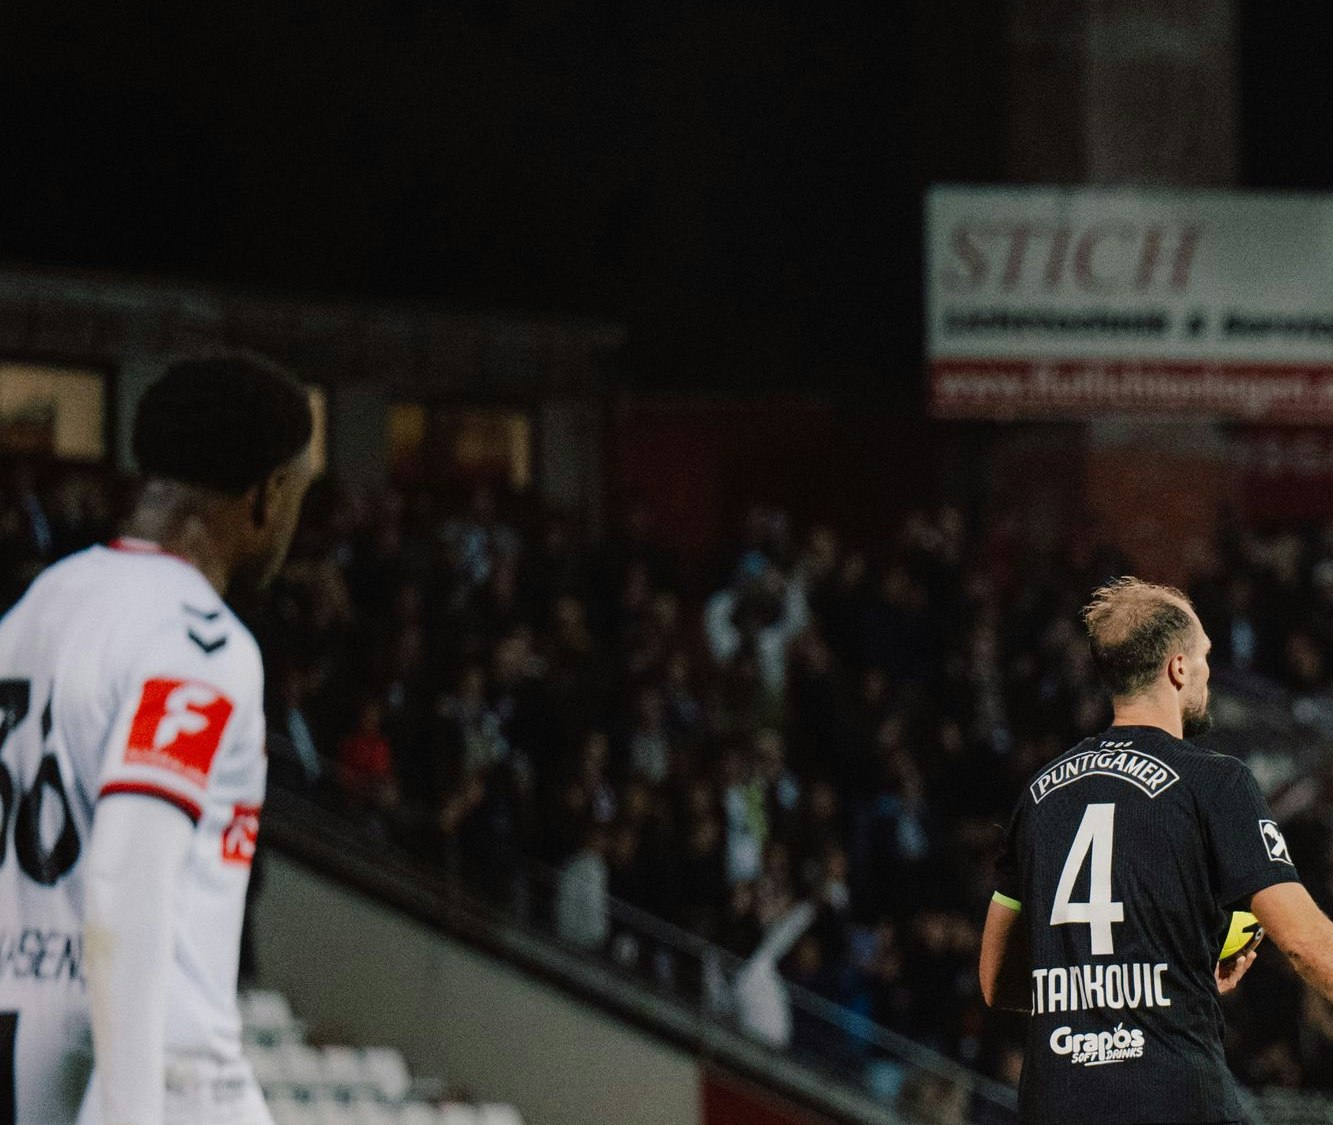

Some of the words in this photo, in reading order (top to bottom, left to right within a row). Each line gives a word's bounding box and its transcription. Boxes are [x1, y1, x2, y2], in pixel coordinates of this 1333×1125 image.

[943, 221, 1201, 297] STICH
[1036, 752, 1168, 796] PUNTIGAMER
[1050, 803, 1124, 955] 4
[1031, 963, 1171, 1015] TANKOVIC
[1071, 1052, 1098, 1064] SOFT
[1106, 1047, 1143, 1060] DRINKS
